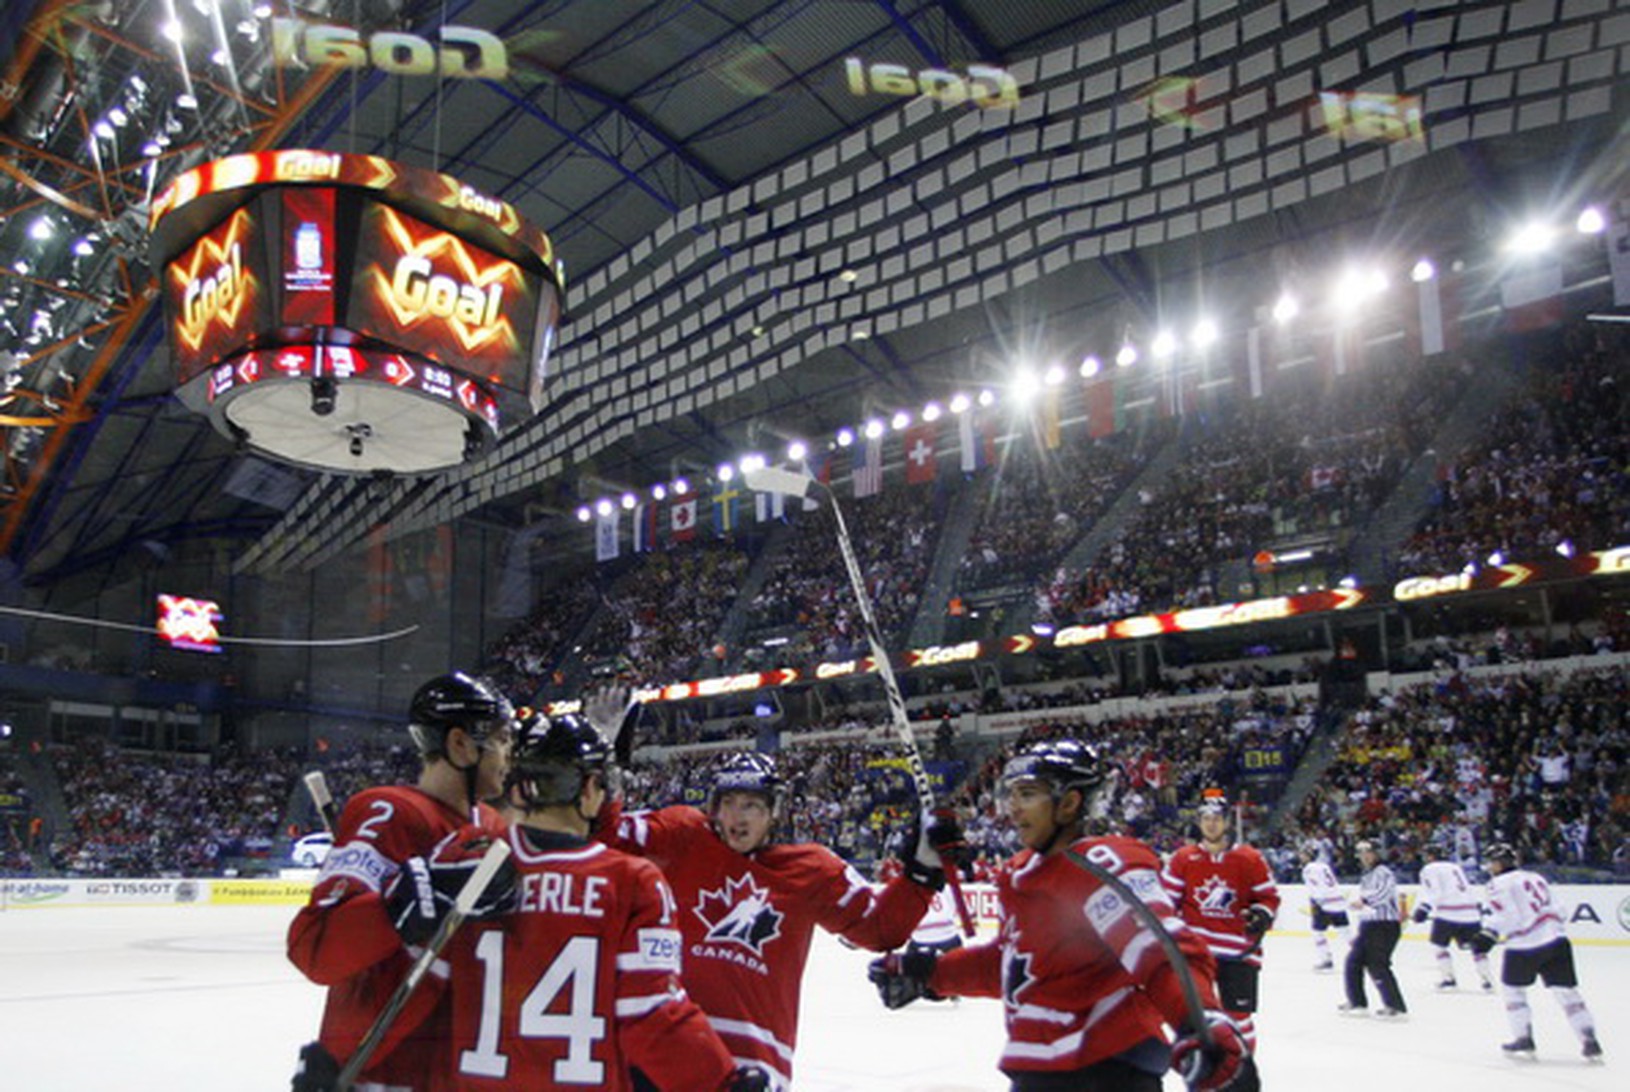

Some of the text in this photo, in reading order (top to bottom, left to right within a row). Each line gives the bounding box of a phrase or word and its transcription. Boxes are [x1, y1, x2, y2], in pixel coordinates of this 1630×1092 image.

[279, 152, 341, 180] Goal
[460, 184, 502, 222] Goal
[185, 242, 241, 333] Goal
[393, 254, 503, 327] Goal
[1394, 572, 1472, 600] Goal
[357, 800, 394, 838] 2
[1086, 844, 1121, 874] 9
[111, 882, 173, 895] TISSOT
[691, 944, 769, 976] CANADA
[459, 930, 606, 1084] 14
